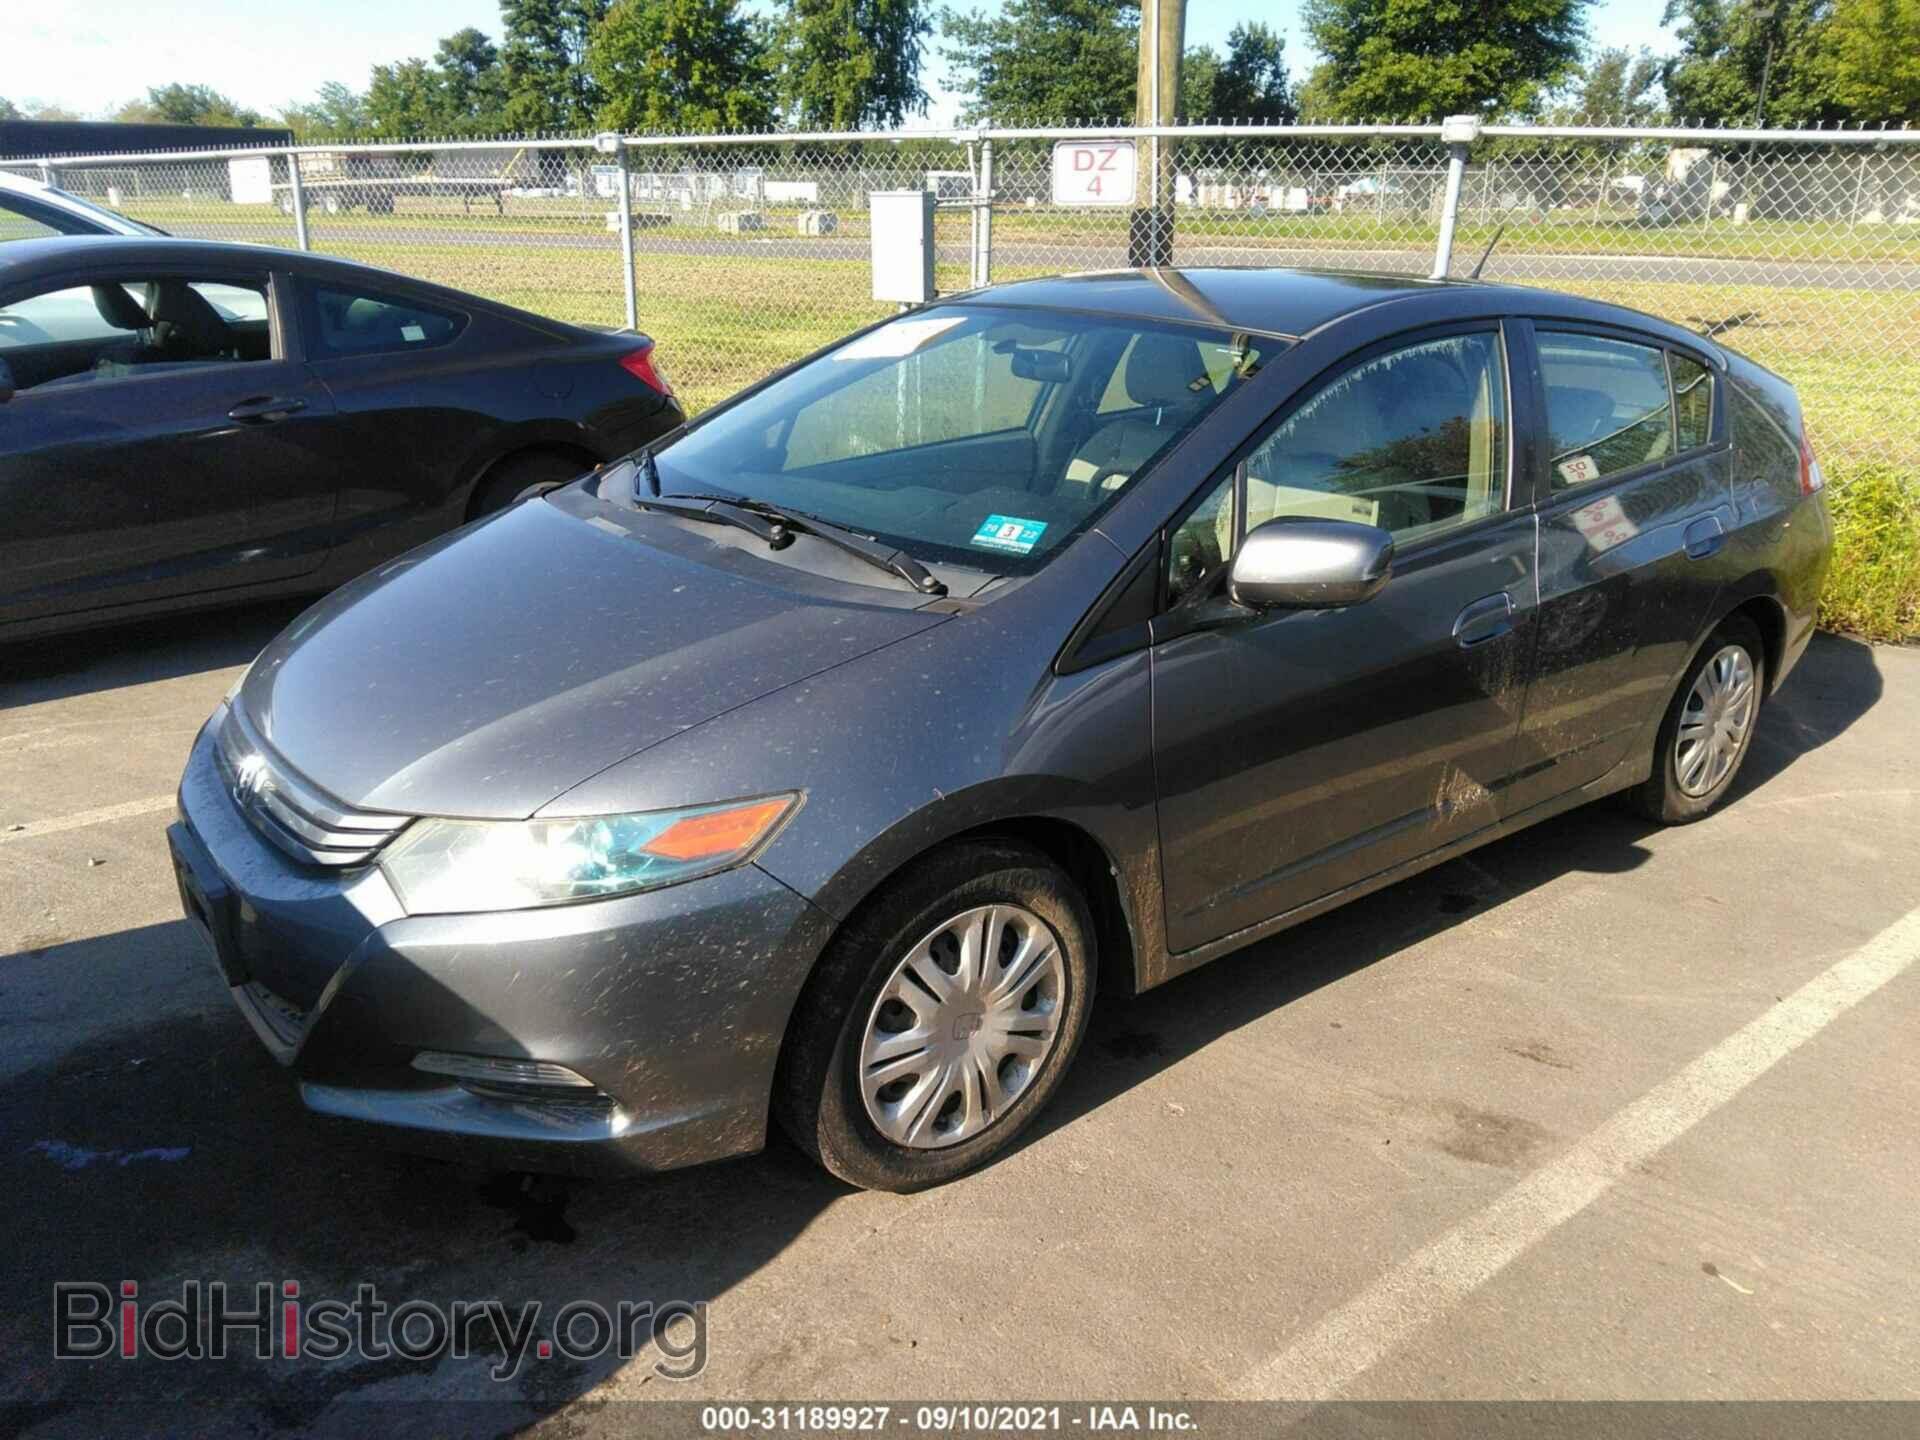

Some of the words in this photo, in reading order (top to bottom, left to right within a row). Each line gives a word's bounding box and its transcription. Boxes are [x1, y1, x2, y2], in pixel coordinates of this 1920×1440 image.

[1073, 149, 1117, 171] DZ
[1086, 175, 1103, 196] 4
[1003, 526, 1015, 537] 3
